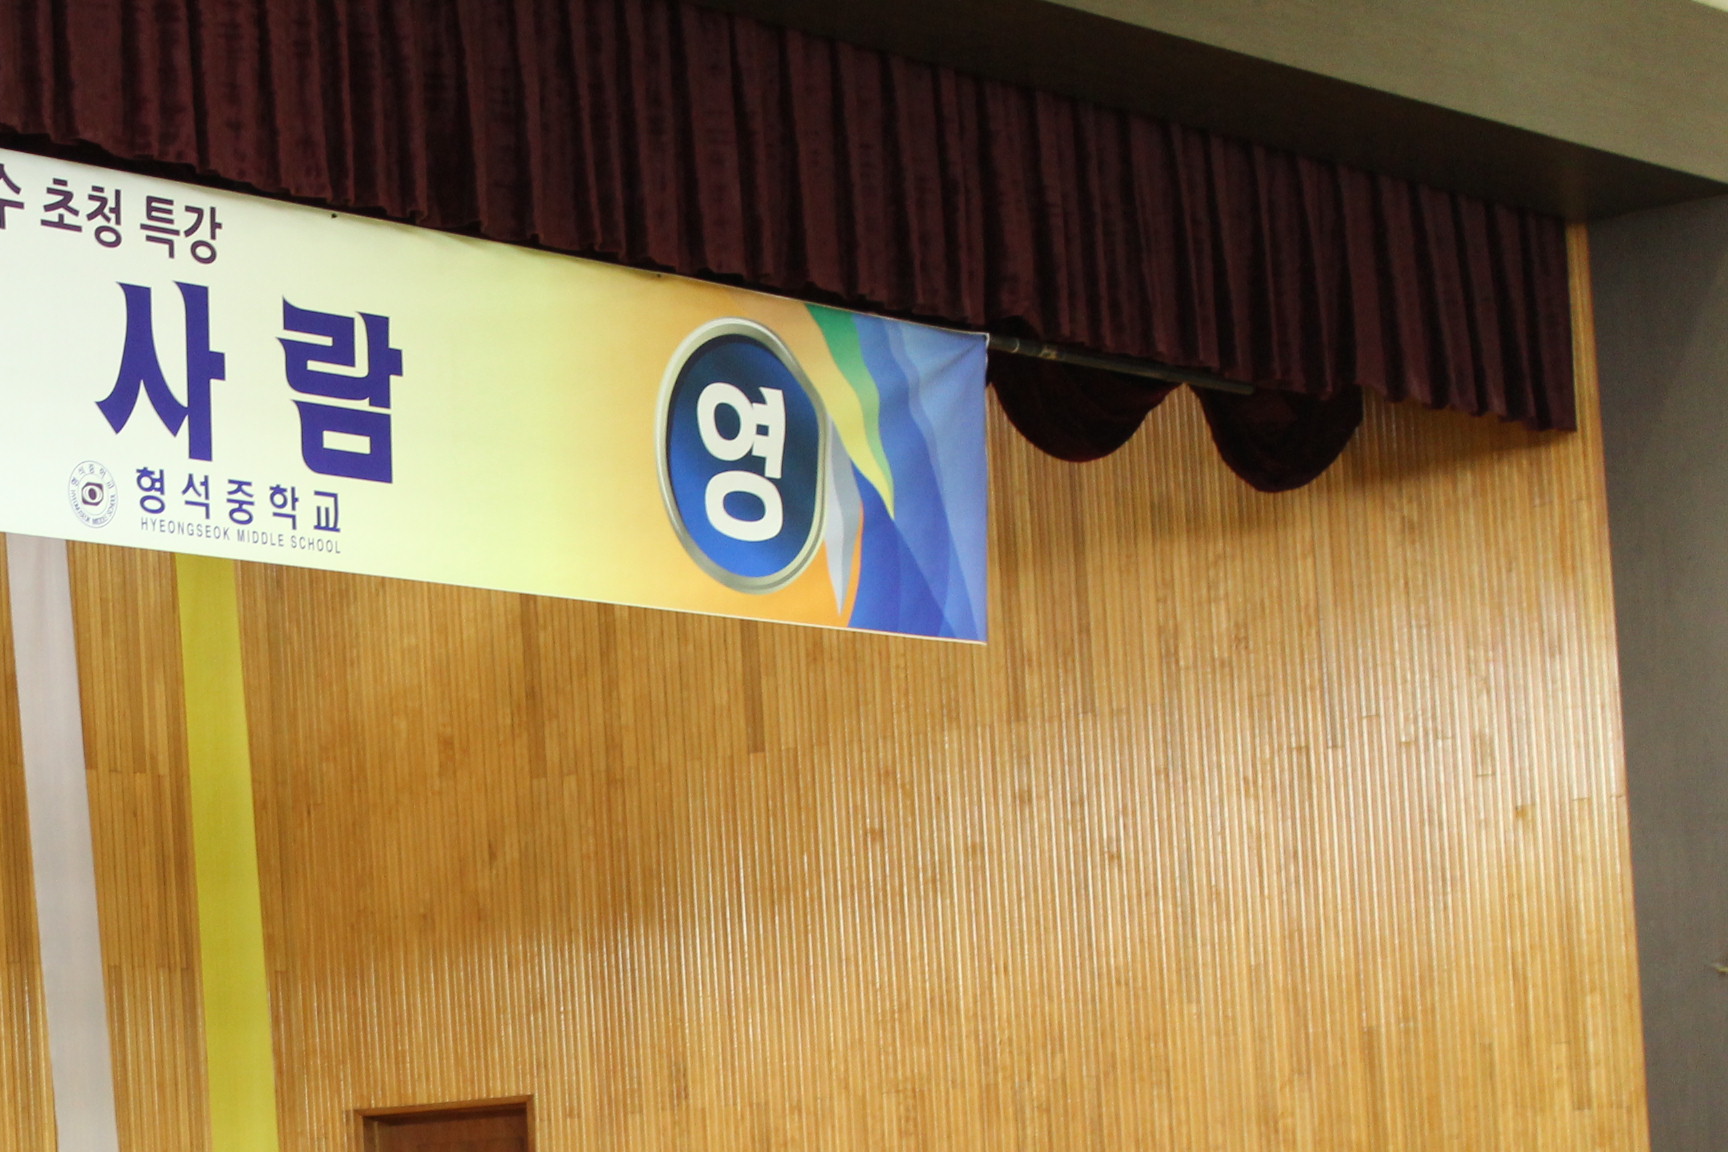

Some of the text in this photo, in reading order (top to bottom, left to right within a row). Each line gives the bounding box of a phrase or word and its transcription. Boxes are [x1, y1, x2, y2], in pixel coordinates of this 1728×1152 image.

[40, 177, 123, 249] 초청
[139, 195, 223, 265] 특강
[95, 280, 403, 484] 사람
[135, 467, 341, 533] 형석중학교
[696, 382, 786, 542] 영
[141, 517, 342, 554] HYEONGSEOK MIDDLE SCHOOL
